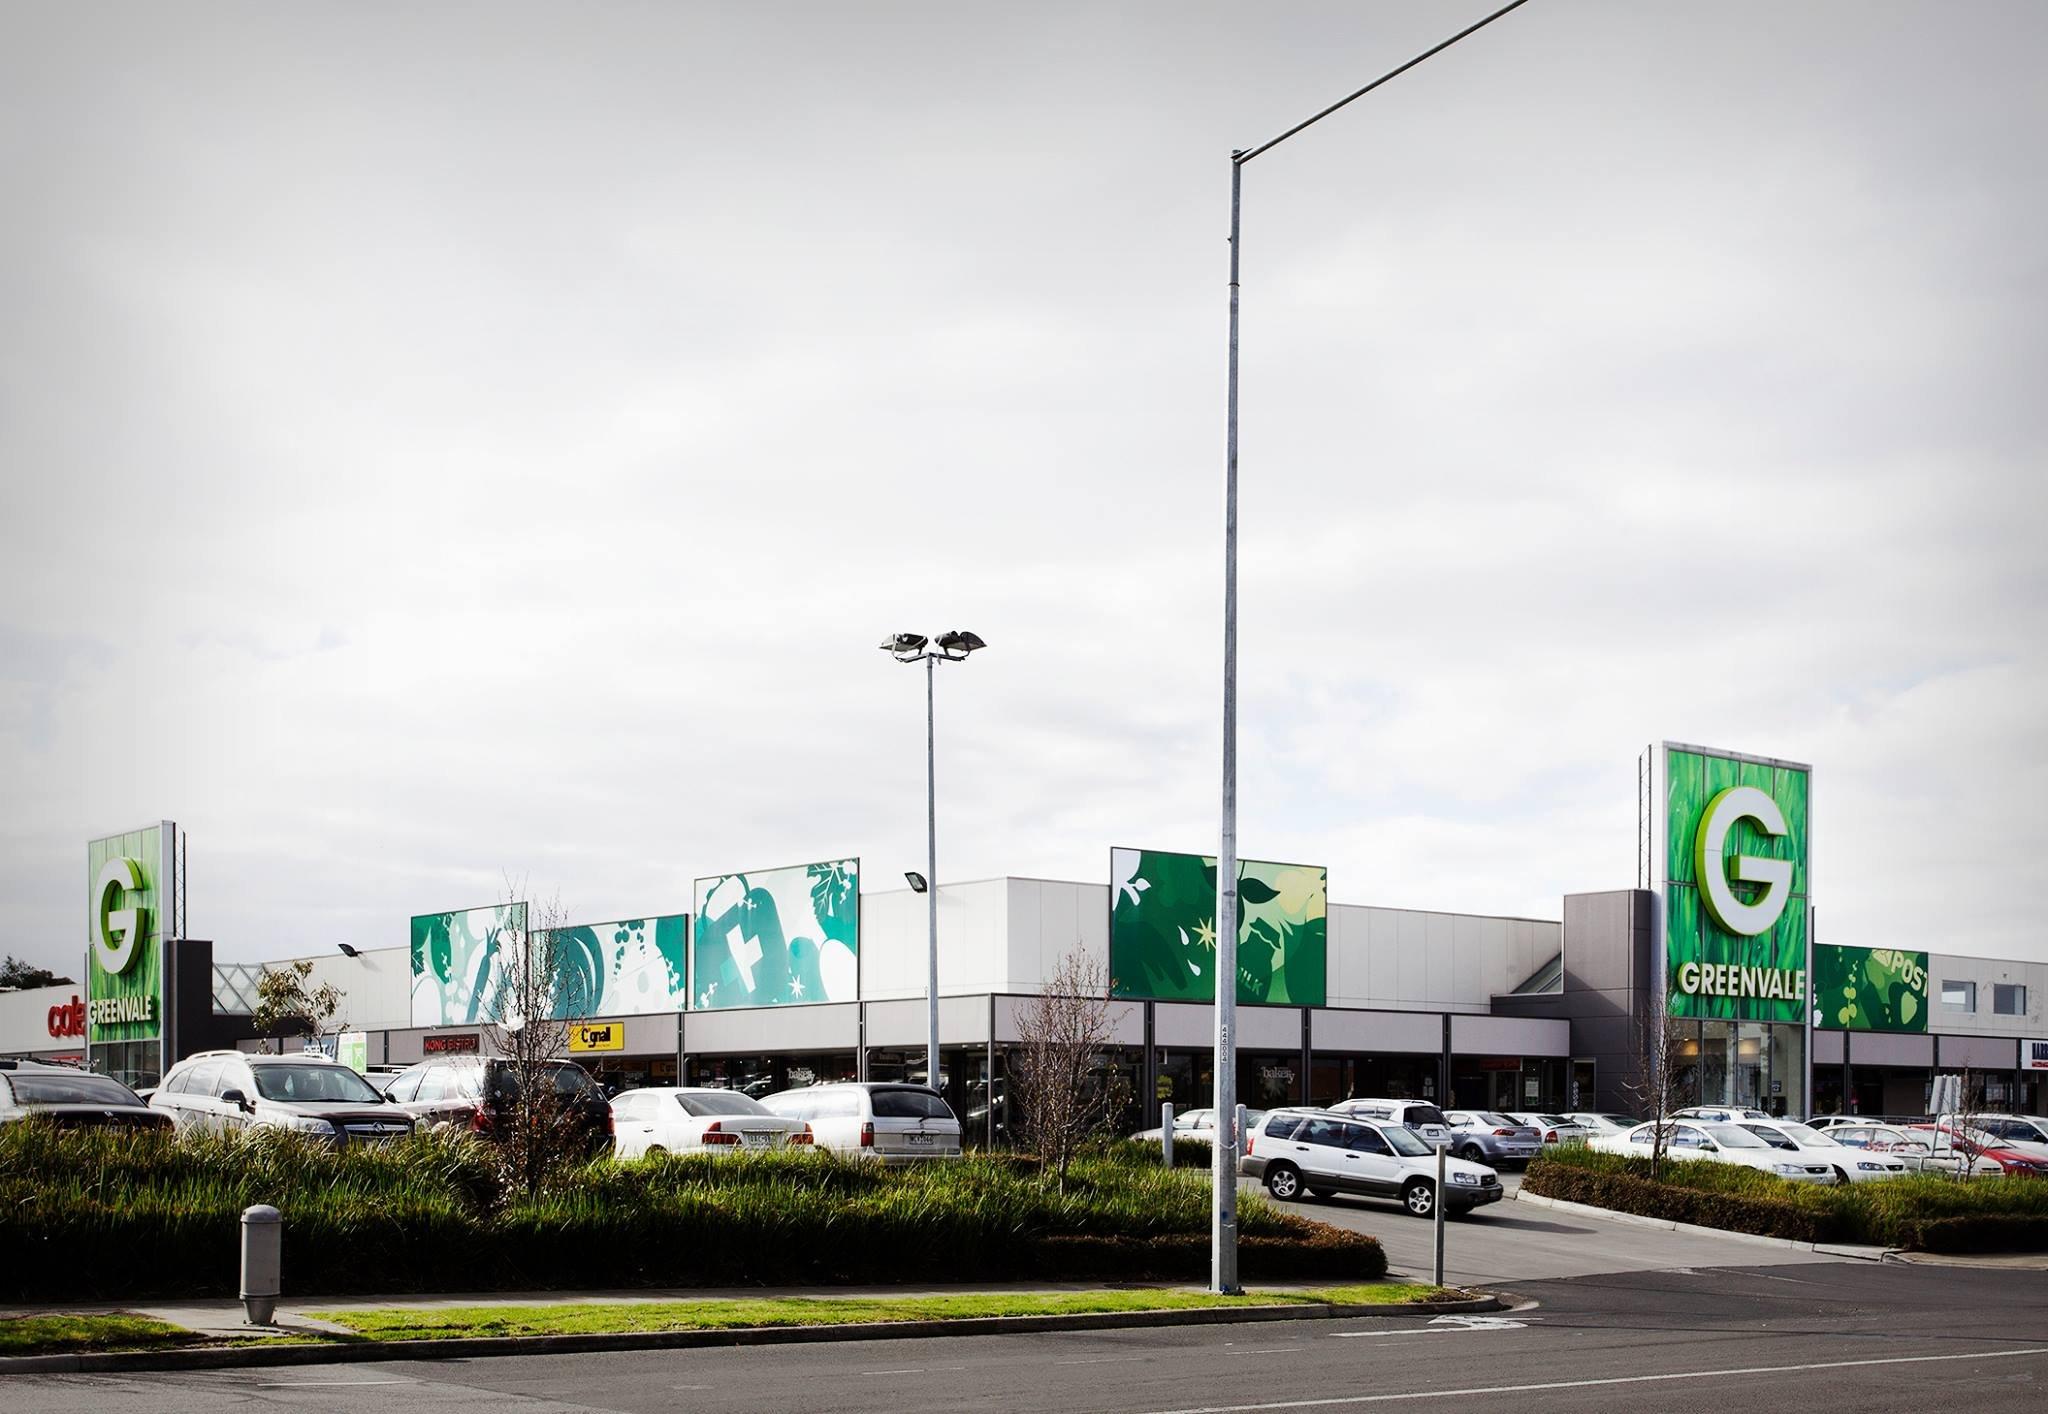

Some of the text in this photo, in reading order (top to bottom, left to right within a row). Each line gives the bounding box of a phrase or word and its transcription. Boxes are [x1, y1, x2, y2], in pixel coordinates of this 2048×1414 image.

[1695, 787, 1793, 935] G
[94, 857, 145, 974] G
[1678, 961, 1805, 1000] GREENVALE
[89, 995, 151, 1025] GREENVALE
[425, 1038, 476, 1051] KONG BISTRO
[1260, 1066, 1295, 1084] bakery
